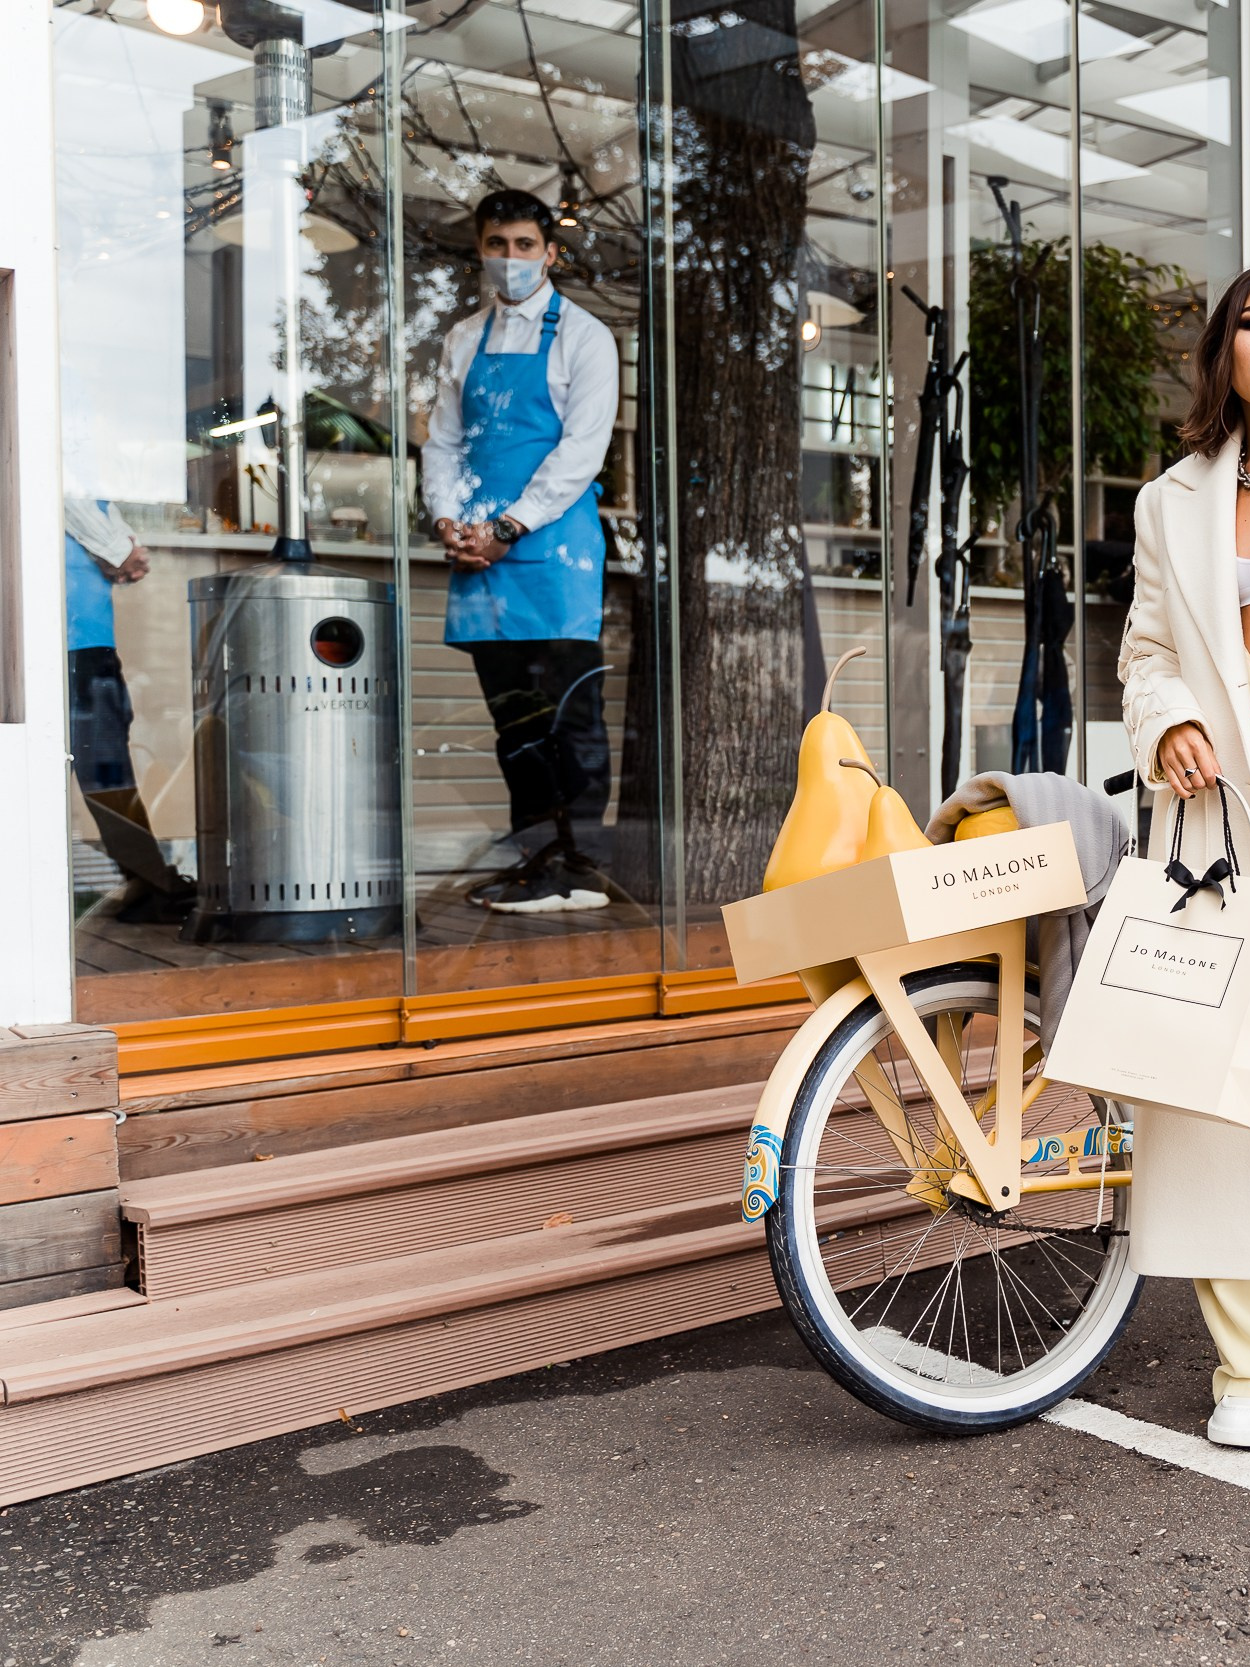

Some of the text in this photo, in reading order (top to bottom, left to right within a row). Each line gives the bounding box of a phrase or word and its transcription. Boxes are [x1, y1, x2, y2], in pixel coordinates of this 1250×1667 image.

[320, 700, 370, 711] VERTEX
[931, 854, 1049, 890] JO MALONE
[972, 883, 1020, 900] LONDON
